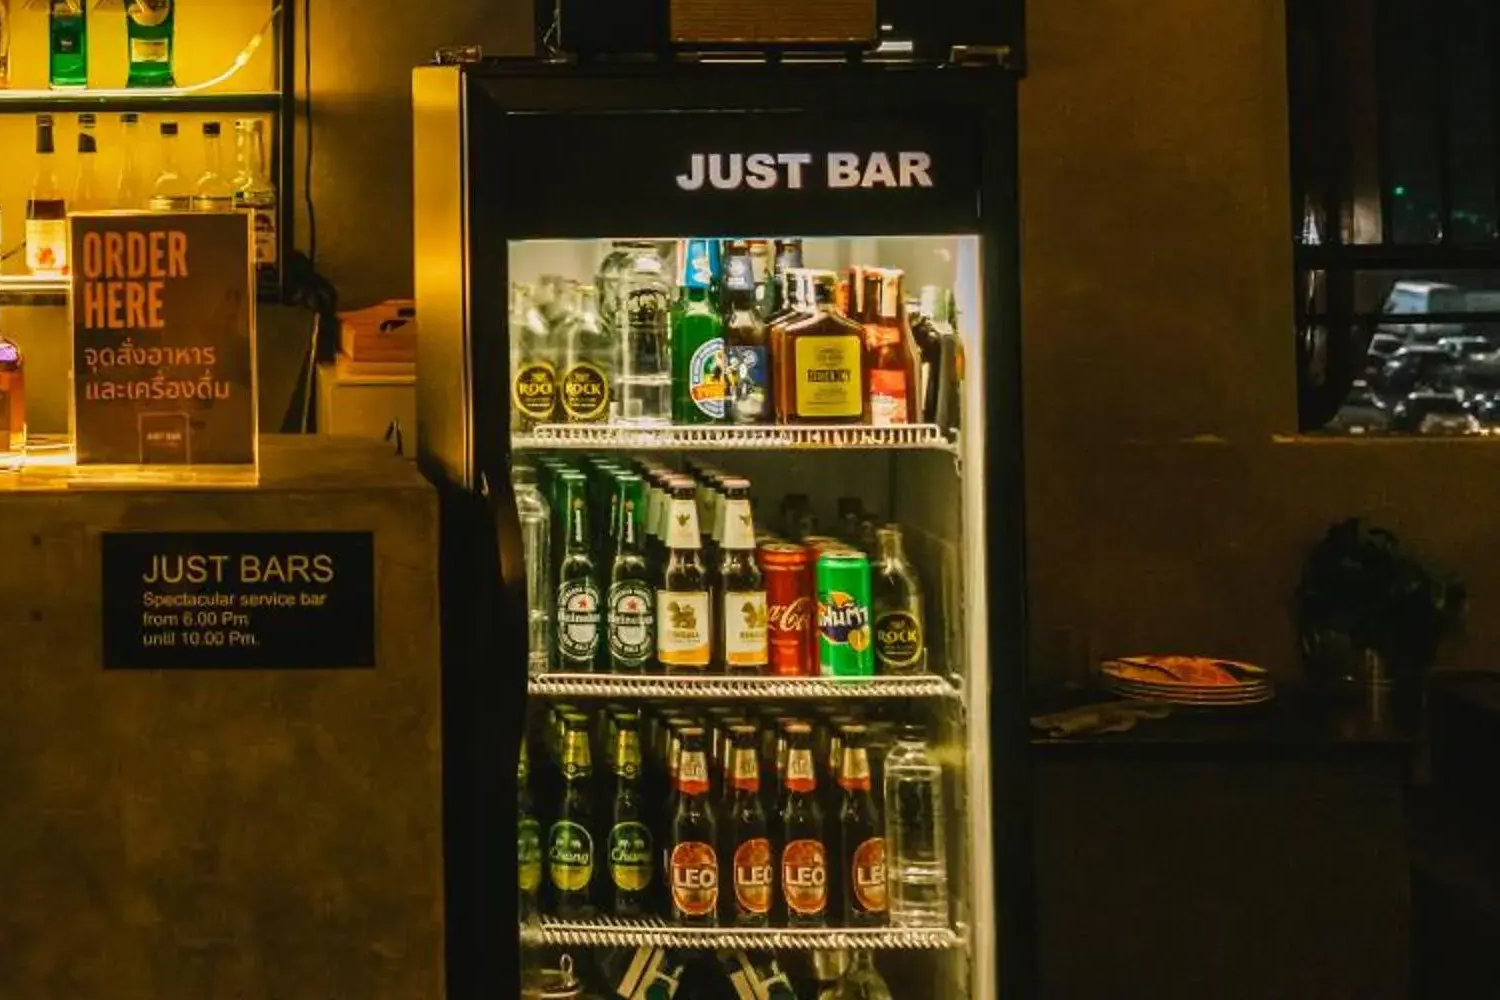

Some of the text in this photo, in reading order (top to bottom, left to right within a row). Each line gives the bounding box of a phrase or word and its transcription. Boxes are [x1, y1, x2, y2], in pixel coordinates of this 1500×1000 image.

[675, 151, 933, 191] JUST BAR
[83, 230, 189, 279] ORDER
[84, 281, 165, 329] HERE
[84, 337, 217, 375] จุดสั่งอาหาร
[86, 368, 230, 400] และเครื่องดื่ม
[565, 381, 602, 396] ROCK
[142, 555, 335, 584] JUST BARS
[142, 592, 328, 608] Spectacular service bar
[143, 612, 178, 627] from
[183, 612, 217, 626] 6.00
[143, 631, 175, 646] until
[181, 631, 225, 646] 10.00
[673, 866, 716, 888] LEO
[785, 866, 826, 886] LEO
